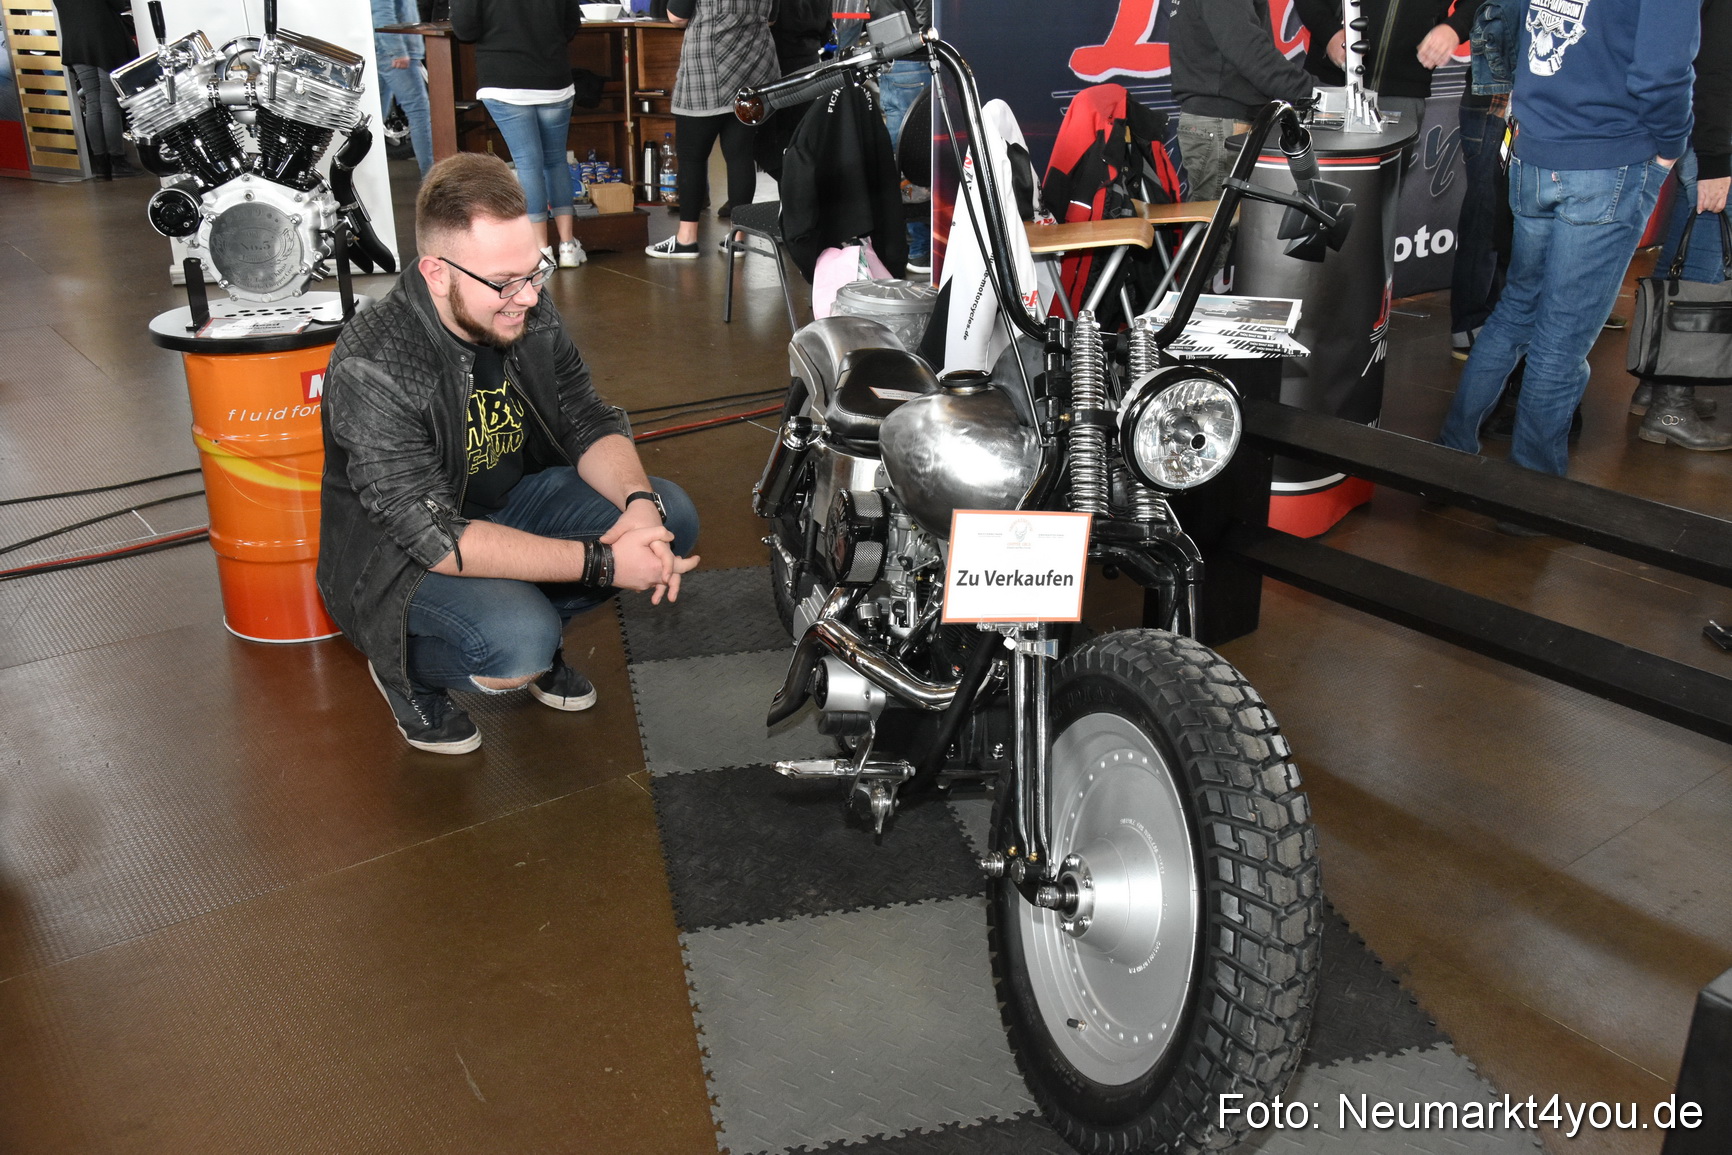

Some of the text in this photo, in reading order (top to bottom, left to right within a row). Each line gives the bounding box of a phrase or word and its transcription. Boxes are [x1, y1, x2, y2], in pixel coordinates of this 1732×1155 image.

[1393, 224, 1458, 262] oto
[291, 404, 322, 418] for
[956, 569, 1074, 586] Zu Verkaufen
